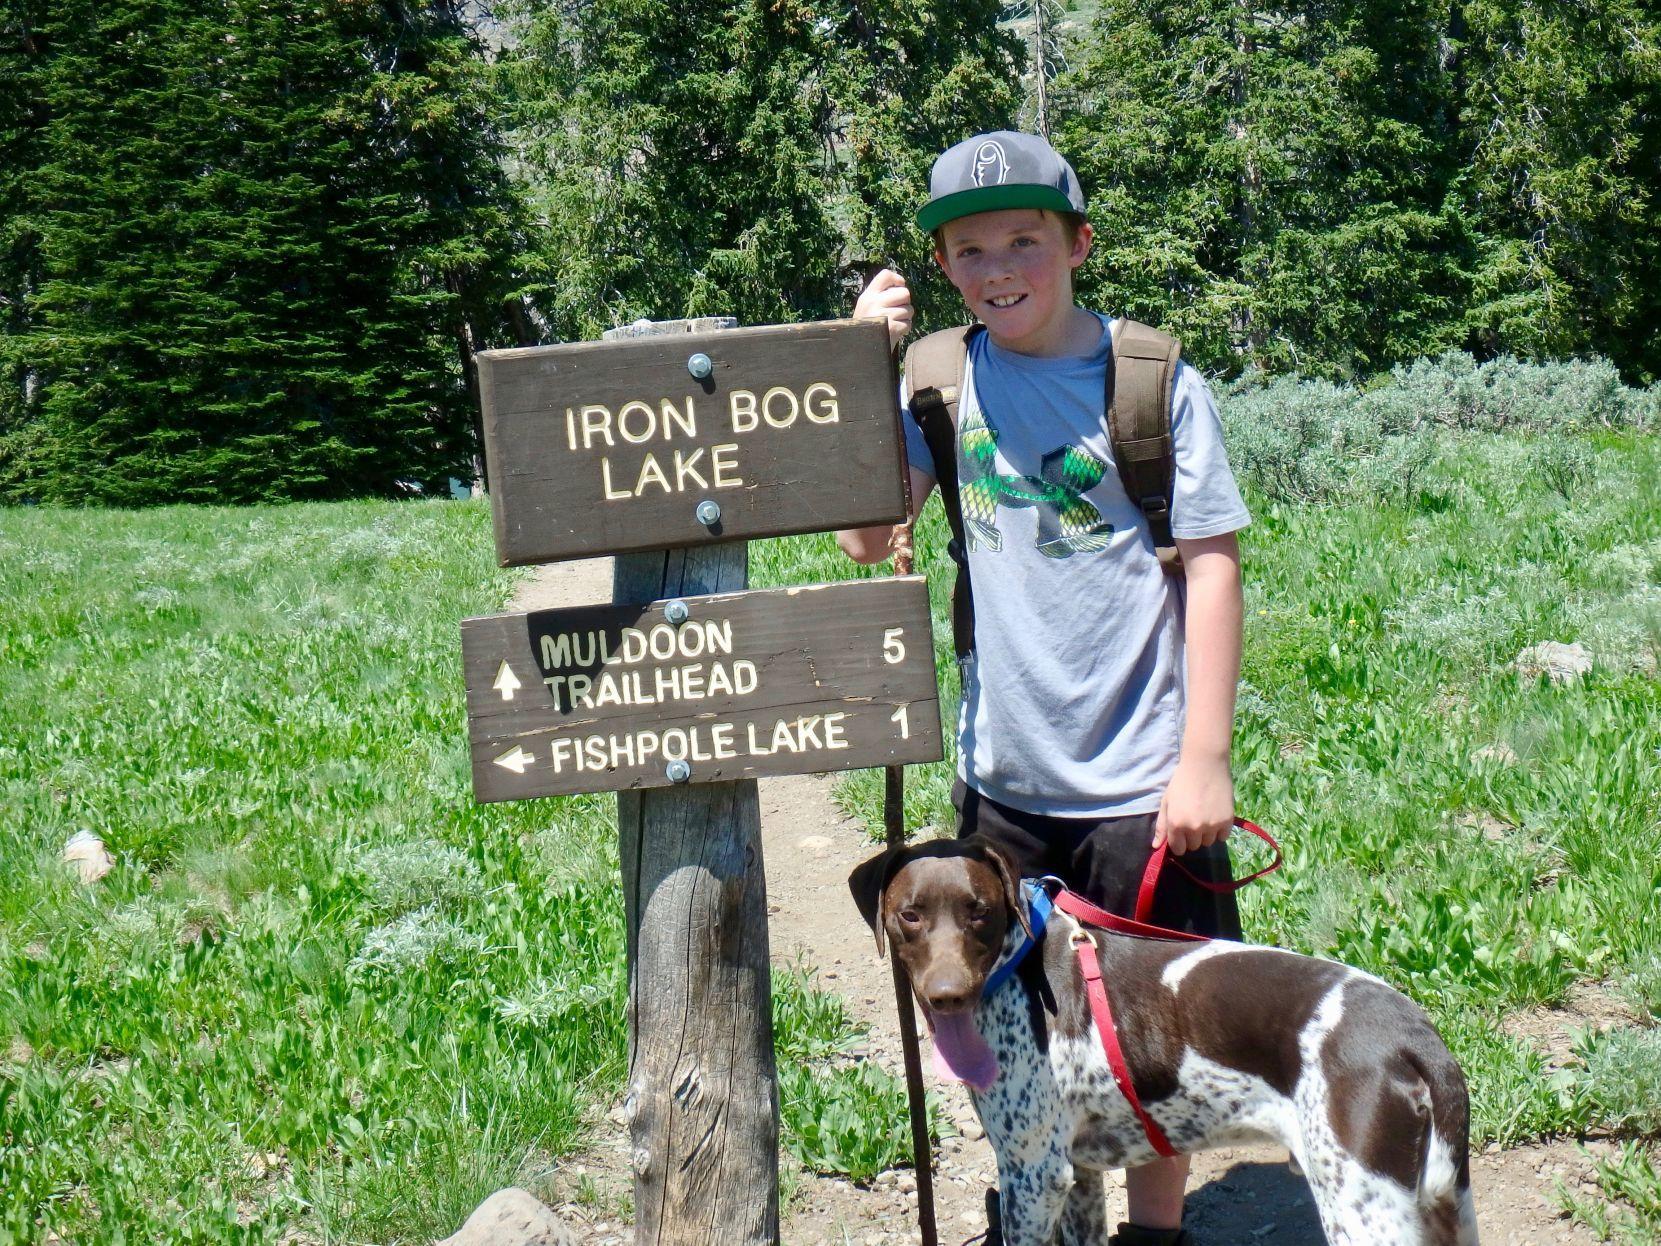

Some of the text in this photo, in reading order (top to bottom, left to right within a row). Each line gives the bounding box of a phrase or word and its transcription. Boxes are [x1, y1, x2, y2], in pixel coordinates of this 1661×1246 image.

[566, 382, 840, 450] IRON BOG
[602, 444, 744, 499] LAKE
[540, 620, 733, 669] MULDOON
[883, 627, 907, 664] 5
[544, 659, 758, 711] TRAILHEAD
[551, 703, 910, 773] FISHPOLE LAKE 1
